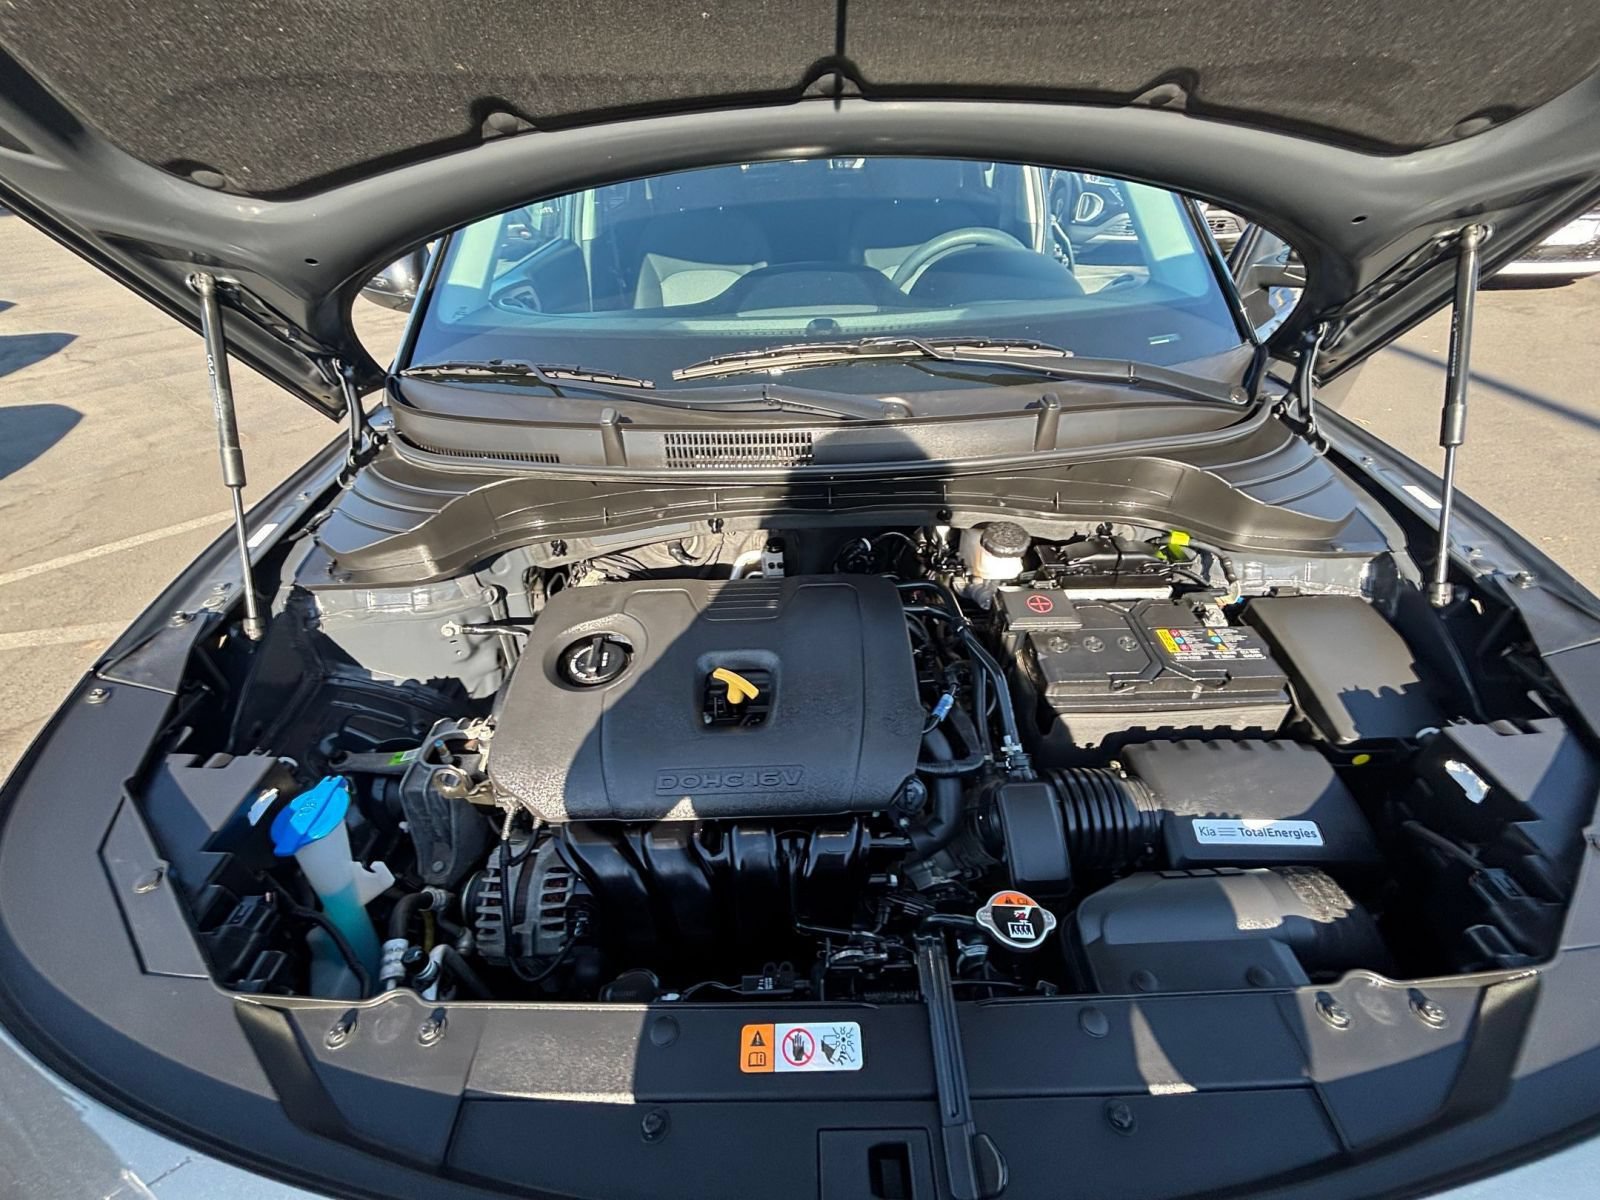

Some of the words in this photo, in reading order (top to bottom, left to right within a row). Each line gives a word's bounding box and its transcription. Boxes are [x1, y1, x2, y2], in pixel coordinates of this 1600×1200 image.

[656, 772, 745, 790] DOHC
[752, 770, 803, 787] 16V
[1199, 826, 1217, 837] Kia
[1238, 827, 1318, 840] TotalEnergies
